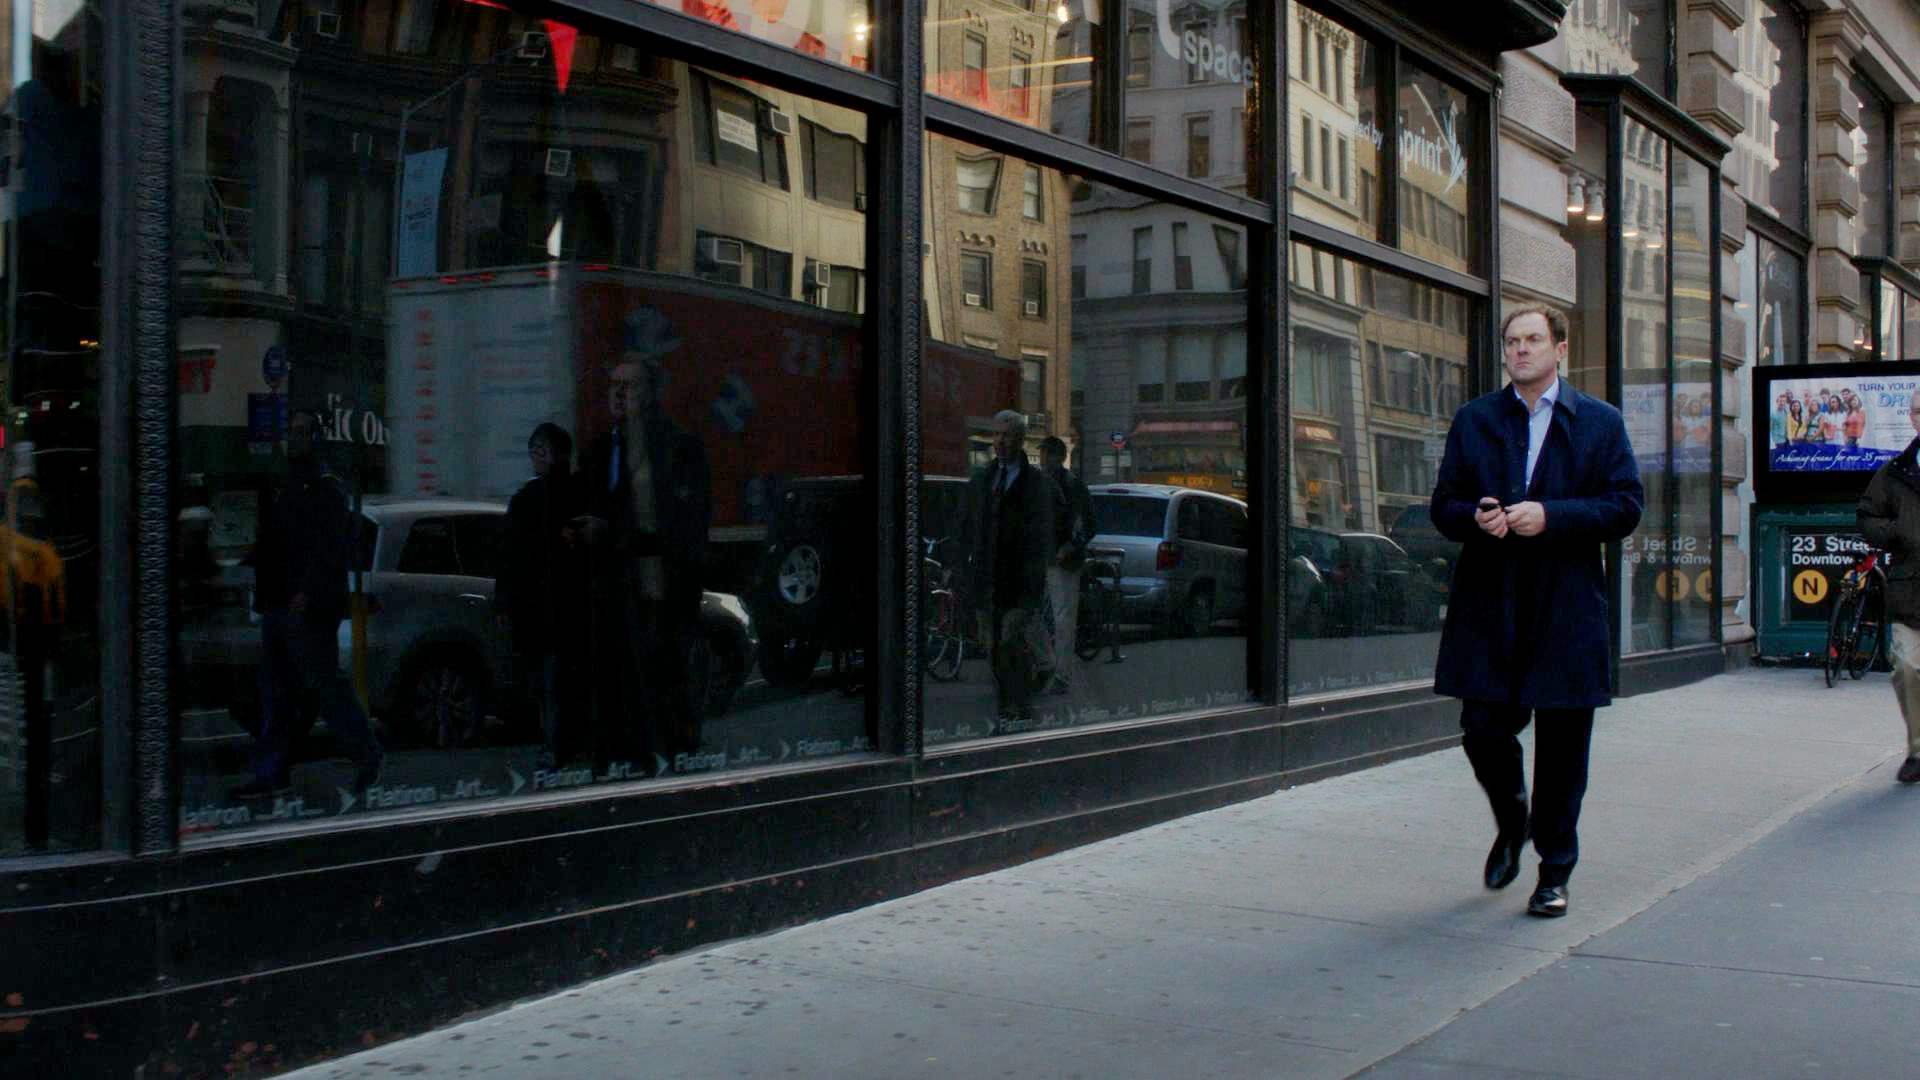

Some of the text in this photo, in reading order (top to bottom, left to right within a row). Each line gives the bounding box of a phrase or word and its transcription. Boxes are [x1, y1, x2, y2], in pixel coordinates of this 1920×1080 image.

[1184, 30, 1254, 87] space
[1857, 383, 1884, 391] TURN
[1792, 536, 1816, 552] 23
[1792, 553, 1854, 565] Downtow
[1802, 577, 1818, 596] N
